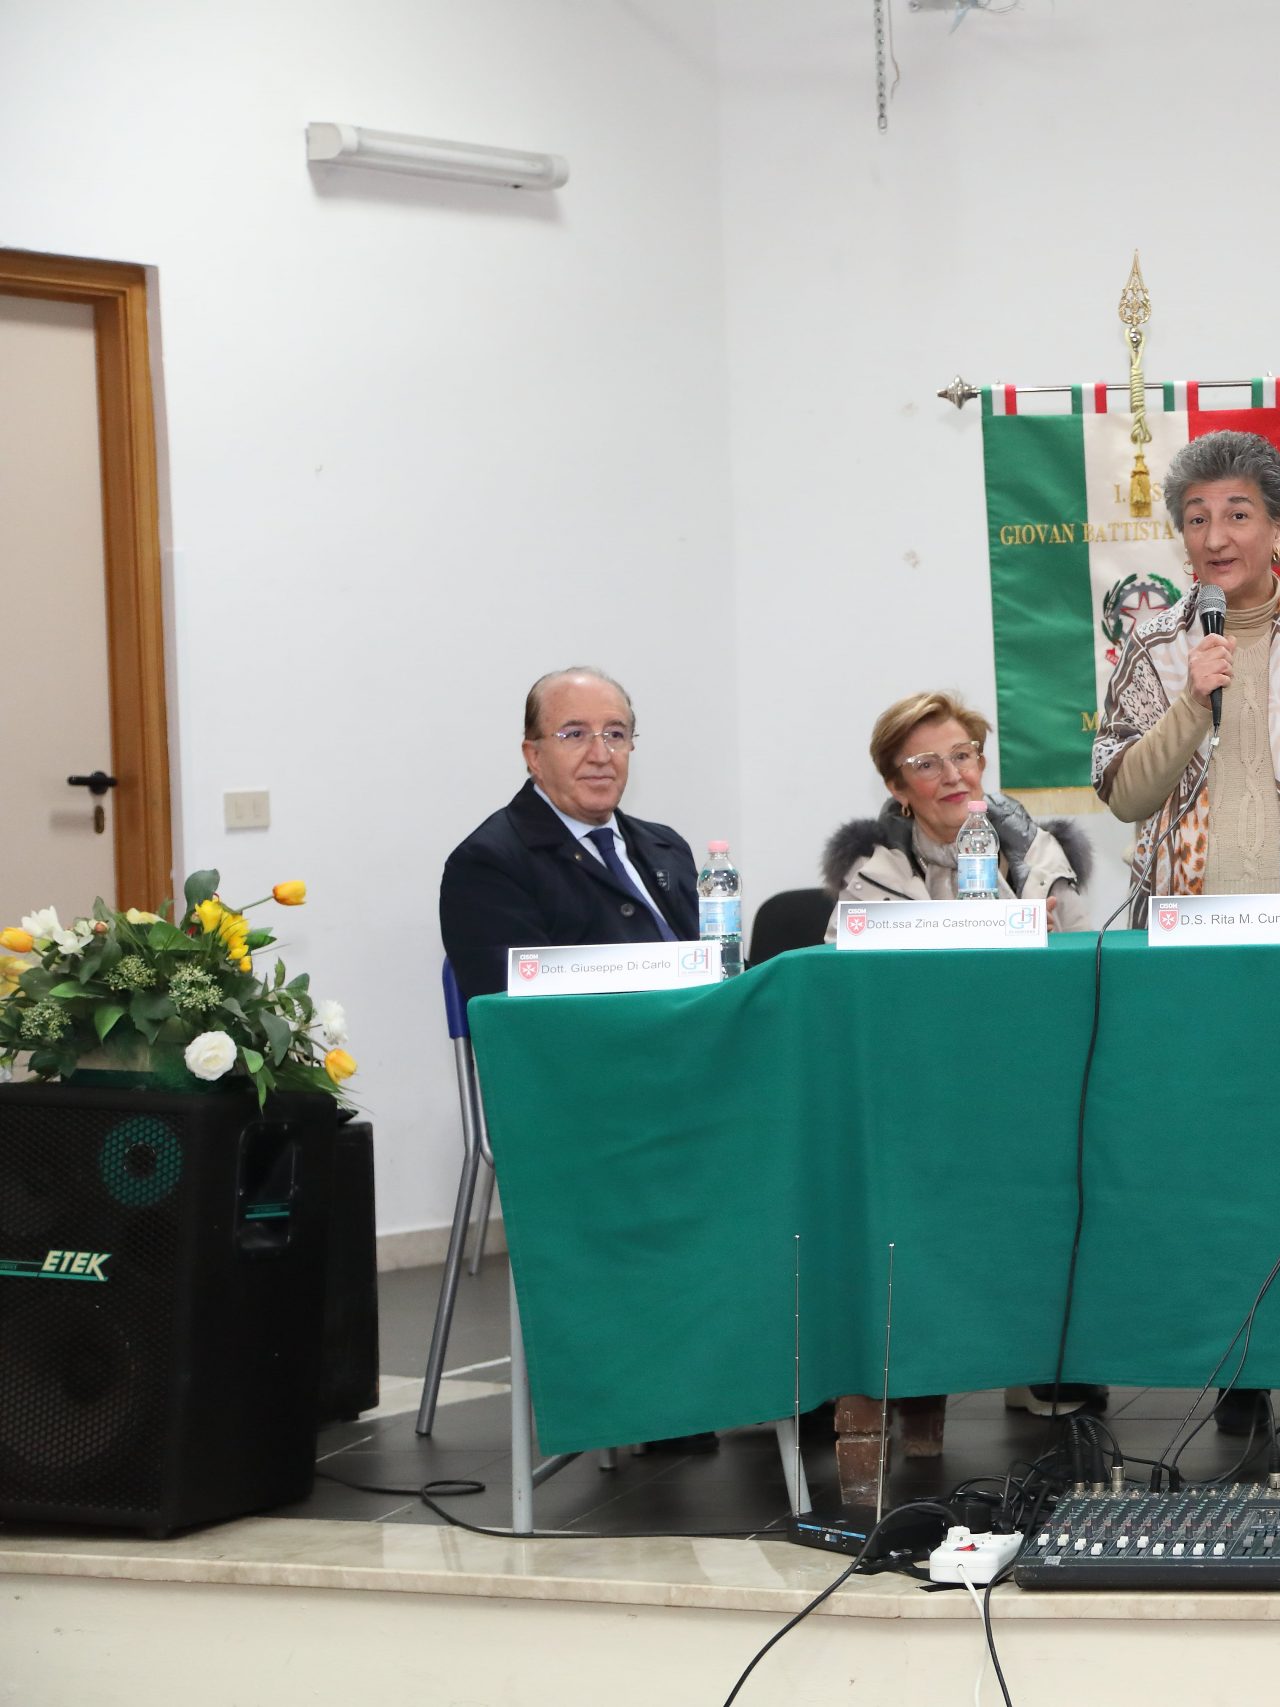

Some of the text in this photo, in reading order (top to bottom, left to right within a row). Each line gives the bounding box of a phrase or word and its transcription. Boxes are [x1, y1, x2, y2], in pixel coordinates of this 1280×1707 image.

[1000, 520, 1177, 545] GIOVAN BATTISTA
[867, 918, 1006, 930] Dott.ssa Zina Castronovo
[1181, 914, 1207, 926] D.S.
[1211, 913, 1235, 925] Rita
[1239, 914, 1254, 925] M.
[541, 959, 671, 975] Dott. Giuseppe Di Carlo
[41, 1250, 112, 1281] ETEK
